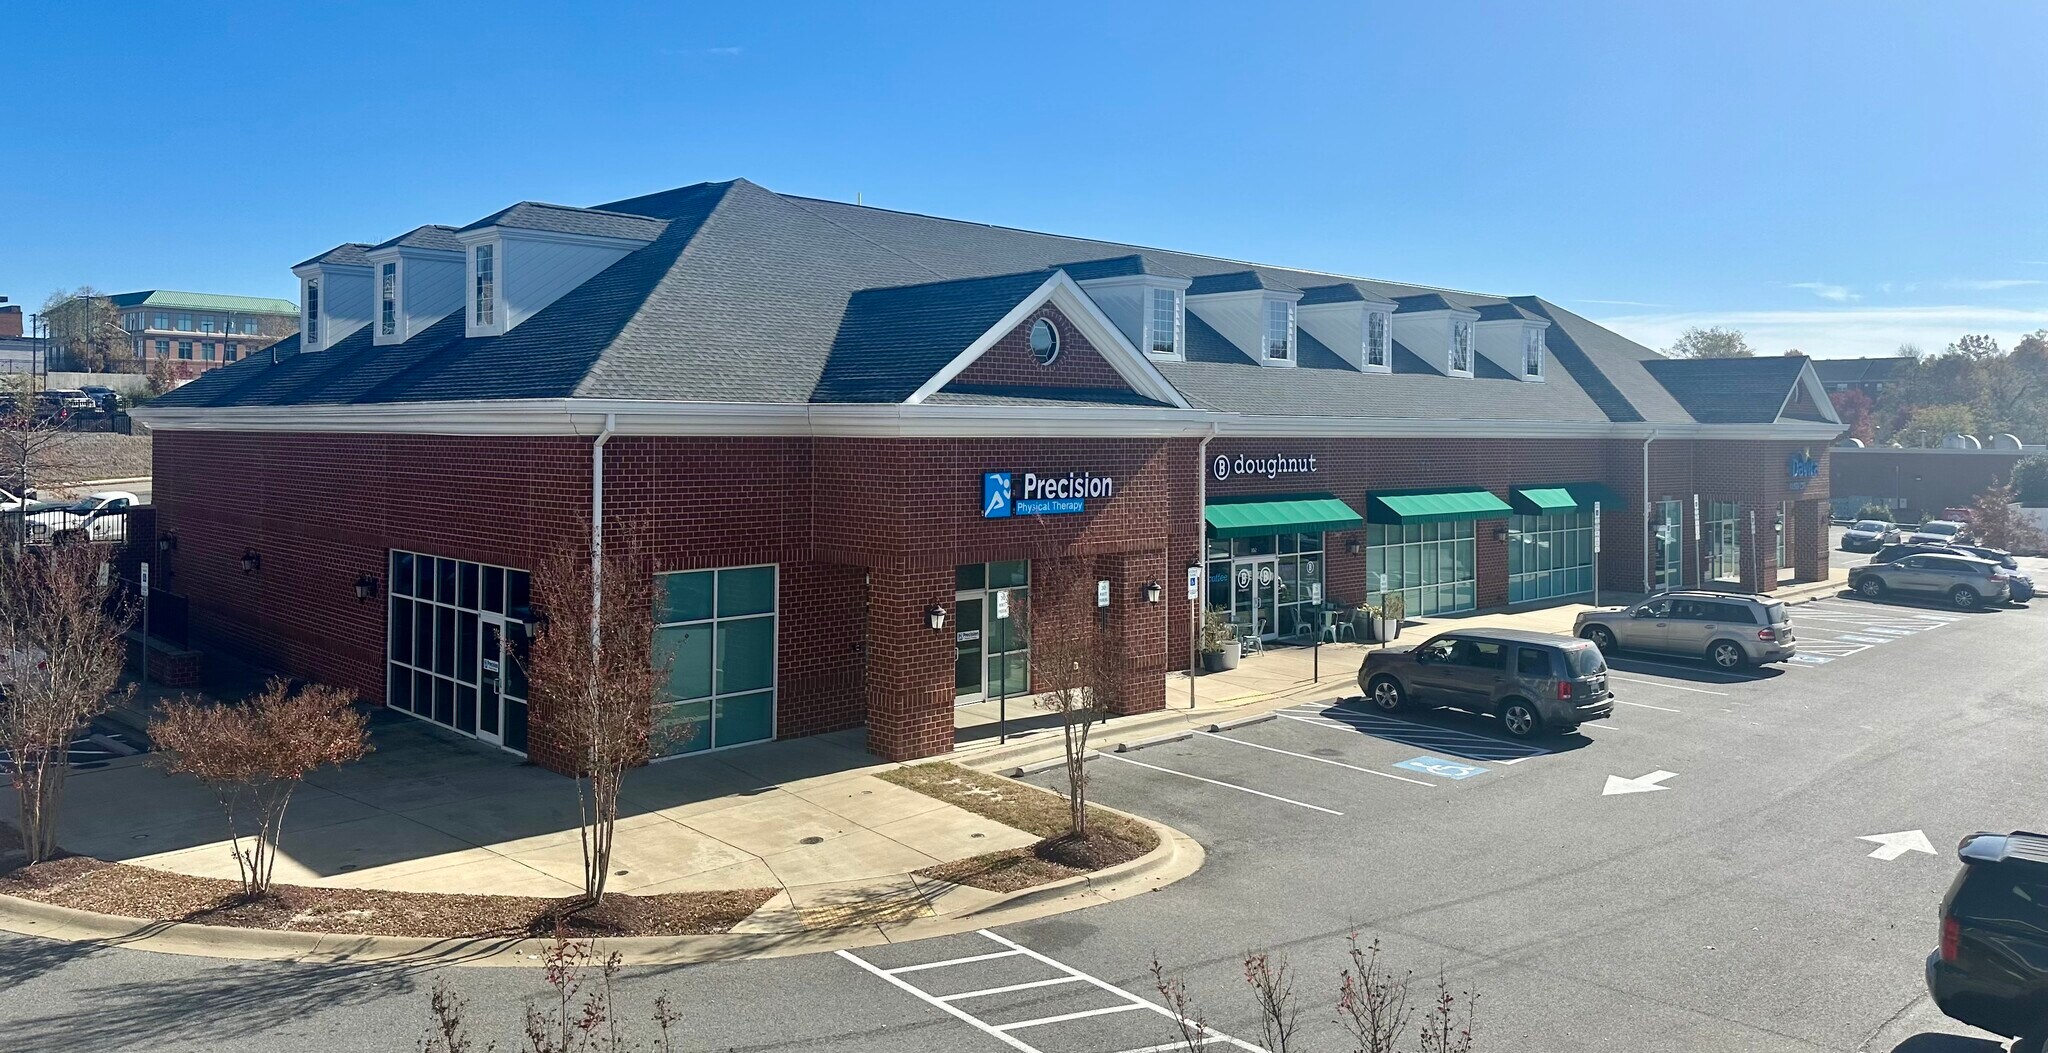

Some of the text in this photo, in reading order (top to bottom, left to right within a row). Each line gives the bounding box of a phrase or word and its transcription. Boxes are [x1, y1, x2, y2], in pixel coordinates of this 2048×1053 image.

[1234, 453, 1317, 479] doughnut
[1024, 472, 1113, 499] Precision
[1017, 501, 1083, 513] Physical Therapy
